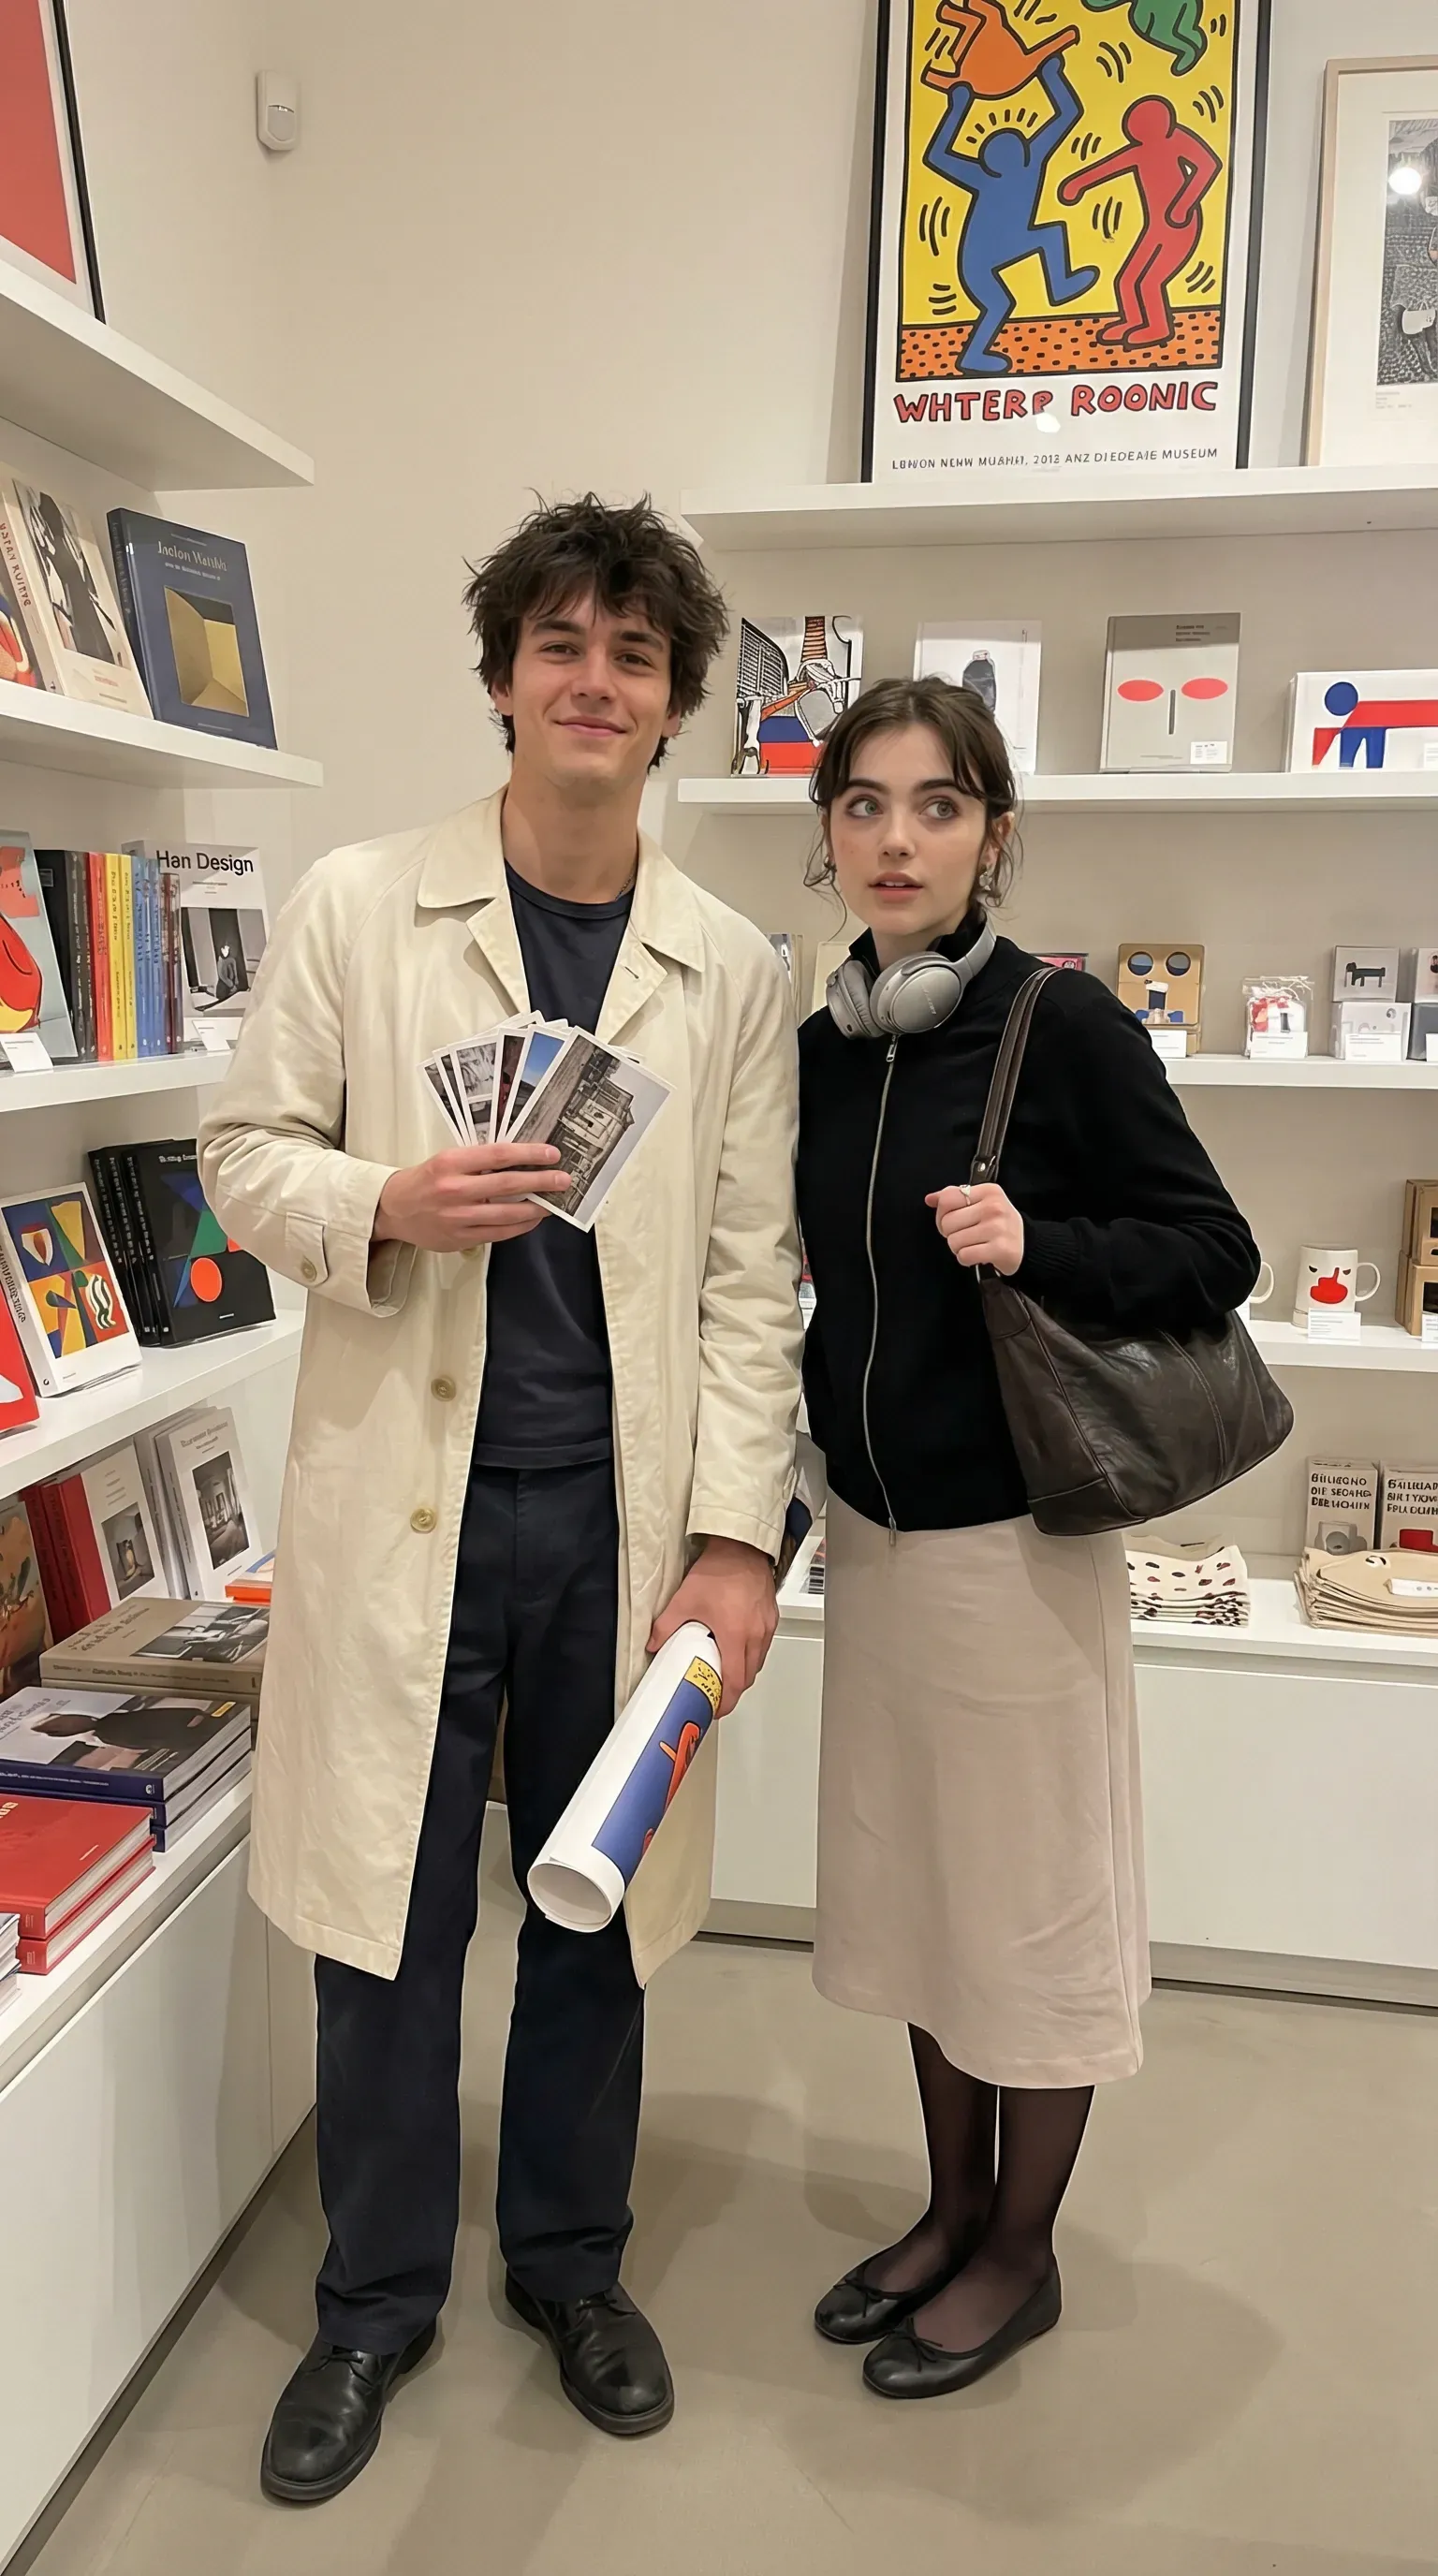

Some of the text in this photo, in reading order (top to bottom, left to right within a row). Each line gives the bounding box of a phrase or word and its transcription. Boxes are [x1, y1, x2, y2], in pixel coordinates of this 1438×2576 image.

[1070, 381, 1219, 417] ROONIC
[1162, 447, 1218, 460] MUSEUM
[156, 849, 255, 877] Han Design
